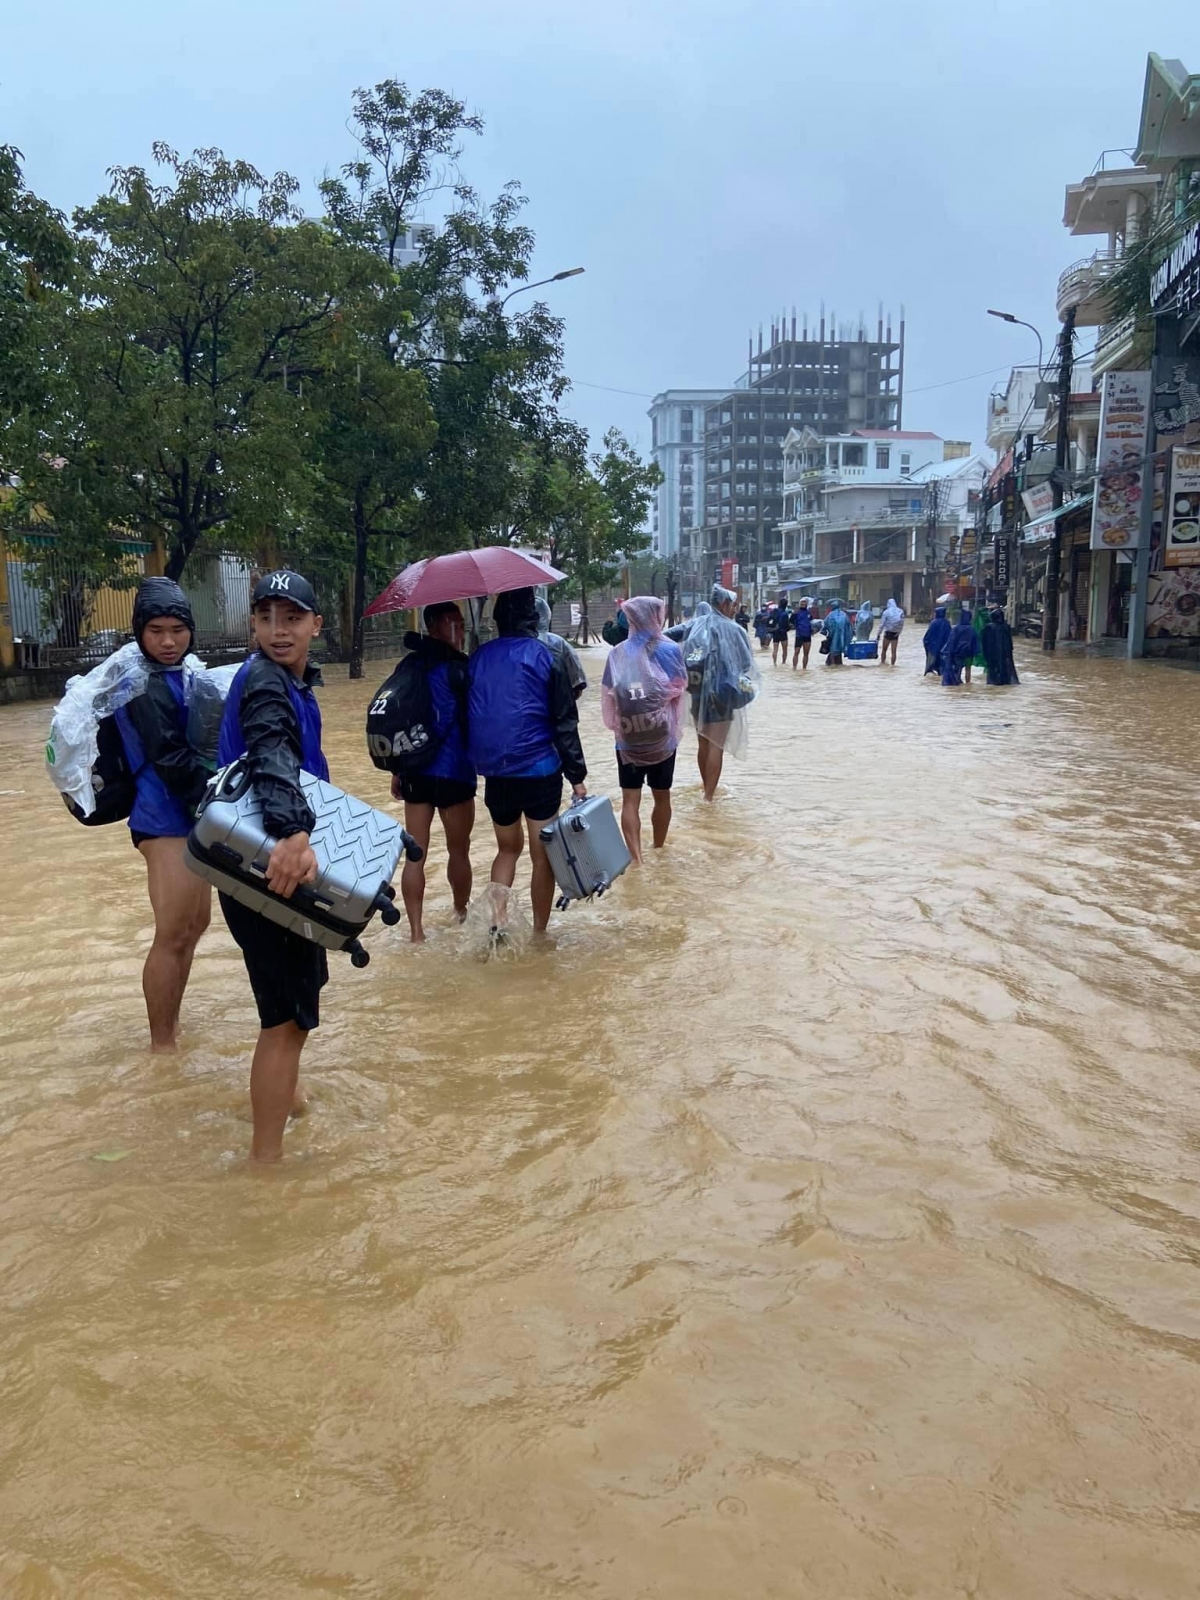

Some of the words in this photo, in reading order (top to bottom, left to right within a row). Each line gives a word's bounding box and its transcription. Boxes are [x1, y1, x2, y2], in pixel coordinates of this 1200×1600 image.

[270, 573, 290, 590] NY
[628, 688, 647, 701] 11
[369, 699, 388, 715] 22
